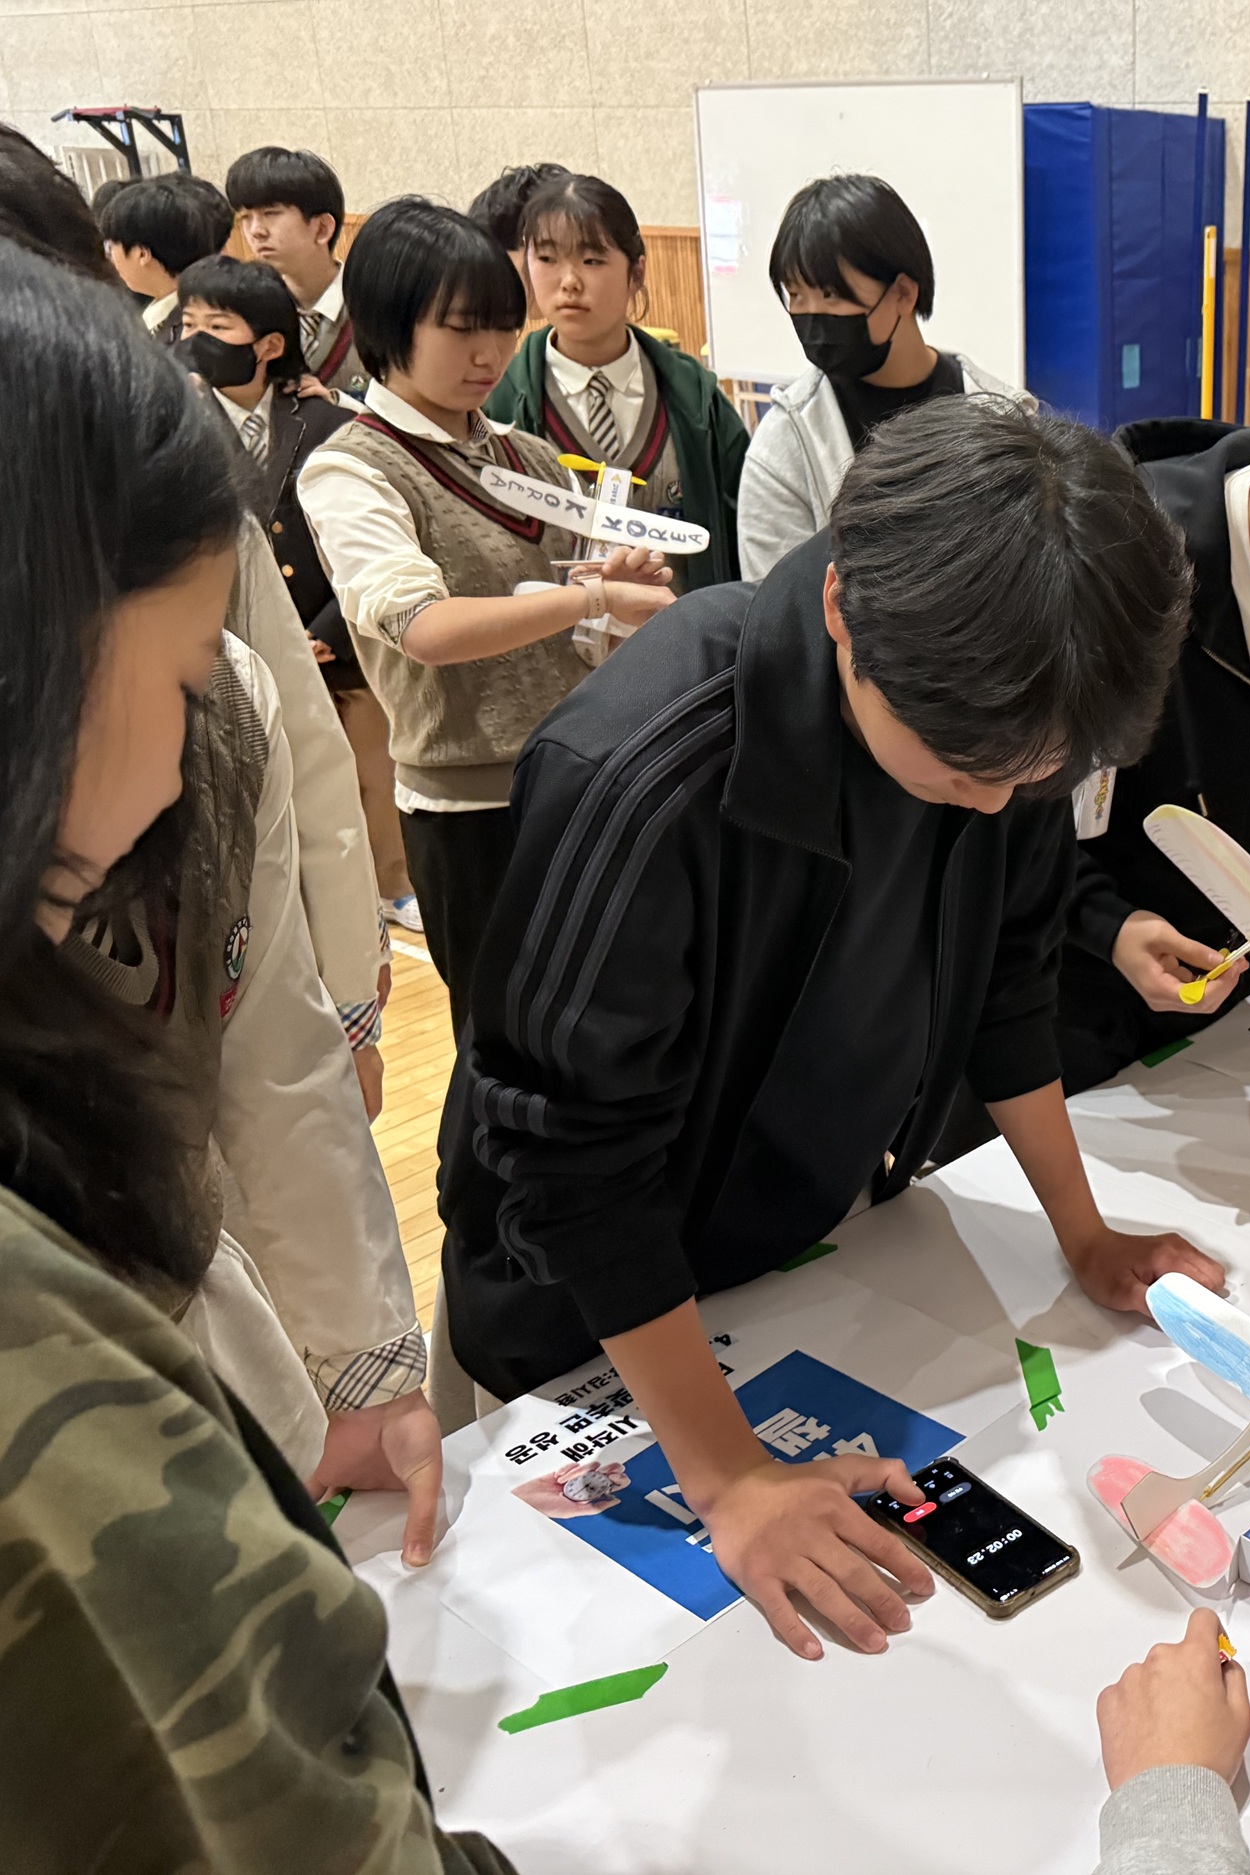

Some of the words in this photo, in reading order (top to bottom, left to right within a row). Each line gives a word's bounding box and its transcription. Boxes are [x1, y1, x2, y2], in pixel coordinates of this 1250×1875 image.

[490, 471, 588, 521] KOREA
[601, 514, 703, 546] KOREA
[504, 1431, 560, 1466] 성공
[560, 1414, 640, 1463] 시작해
